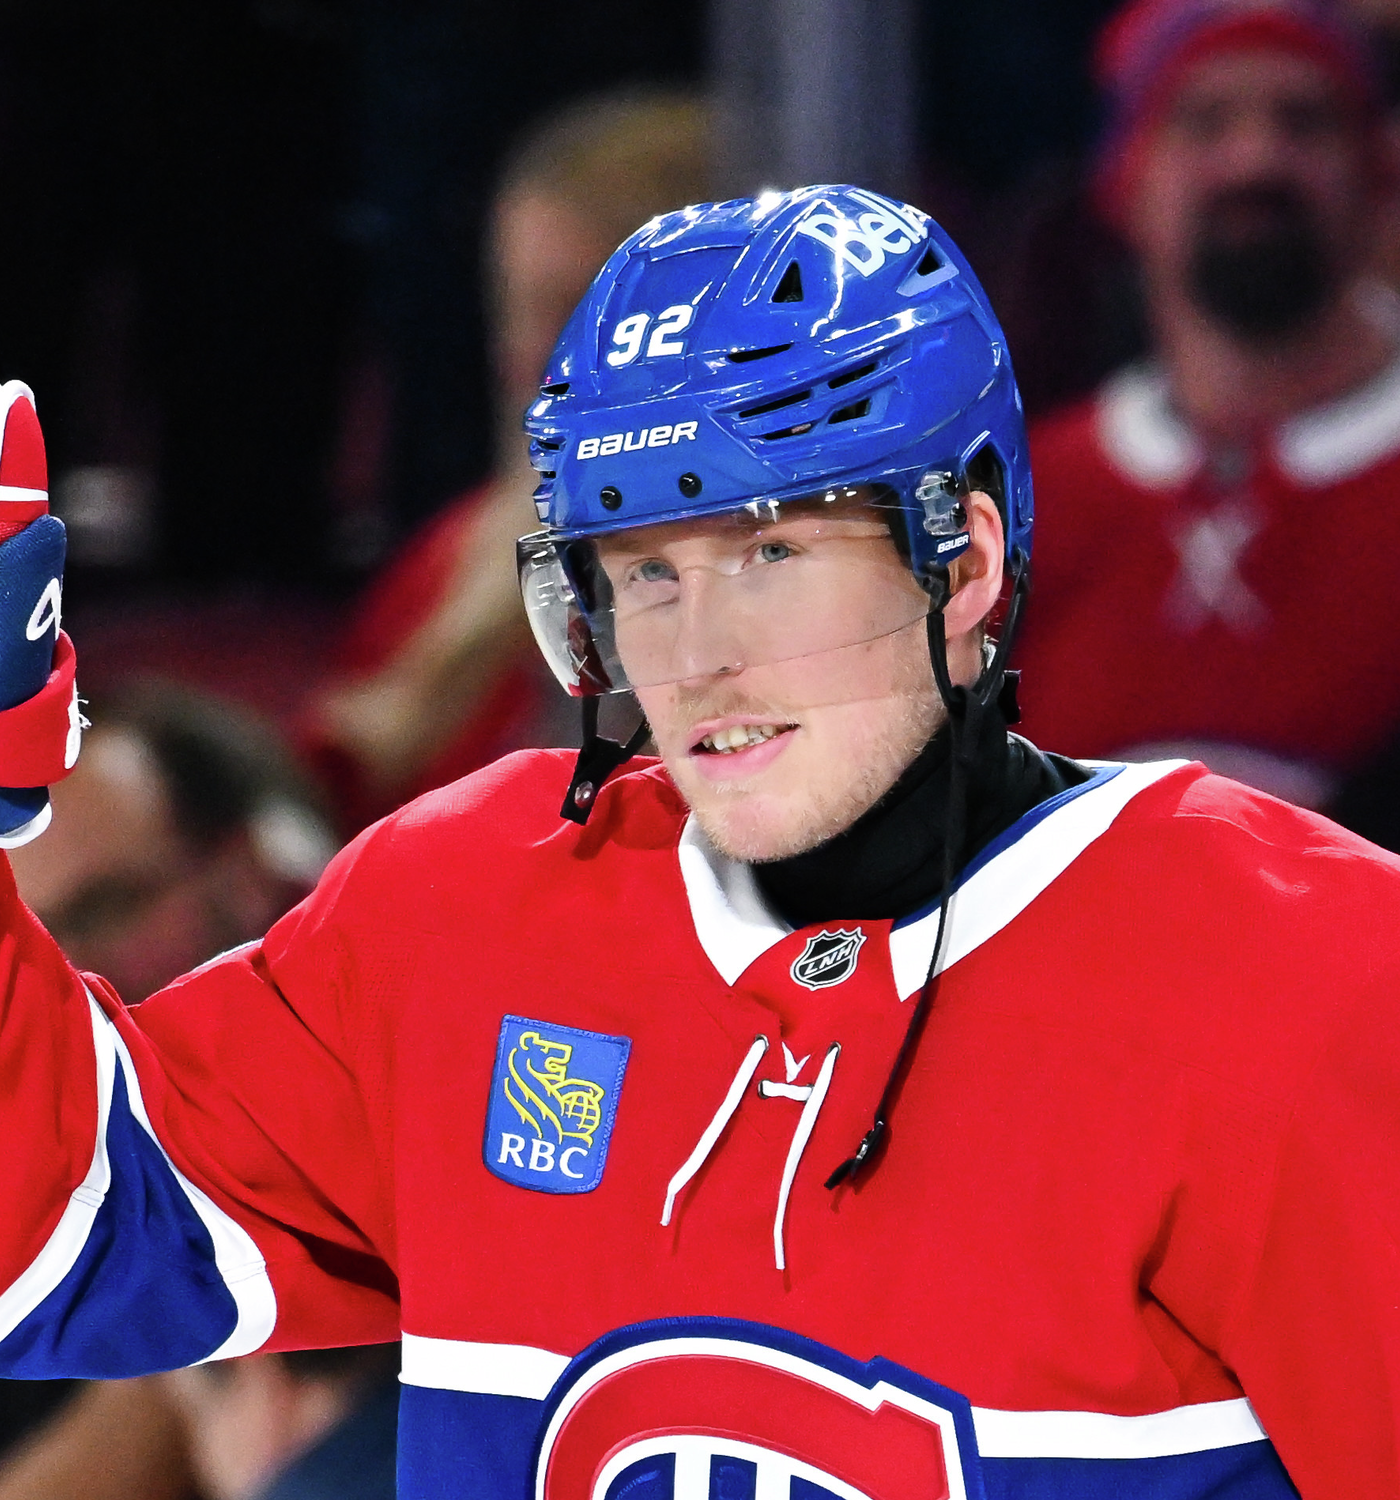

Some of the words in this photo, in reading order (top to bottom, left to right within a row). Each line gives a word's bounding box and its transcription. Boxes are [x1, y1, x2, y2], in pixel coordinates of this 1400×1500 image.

[797, 188, 928, 277] Bell
[607, 305, 693, 366] 92
[803, 941, 854, 976] LNH
[497, 1132, 588, 1179] RBC
